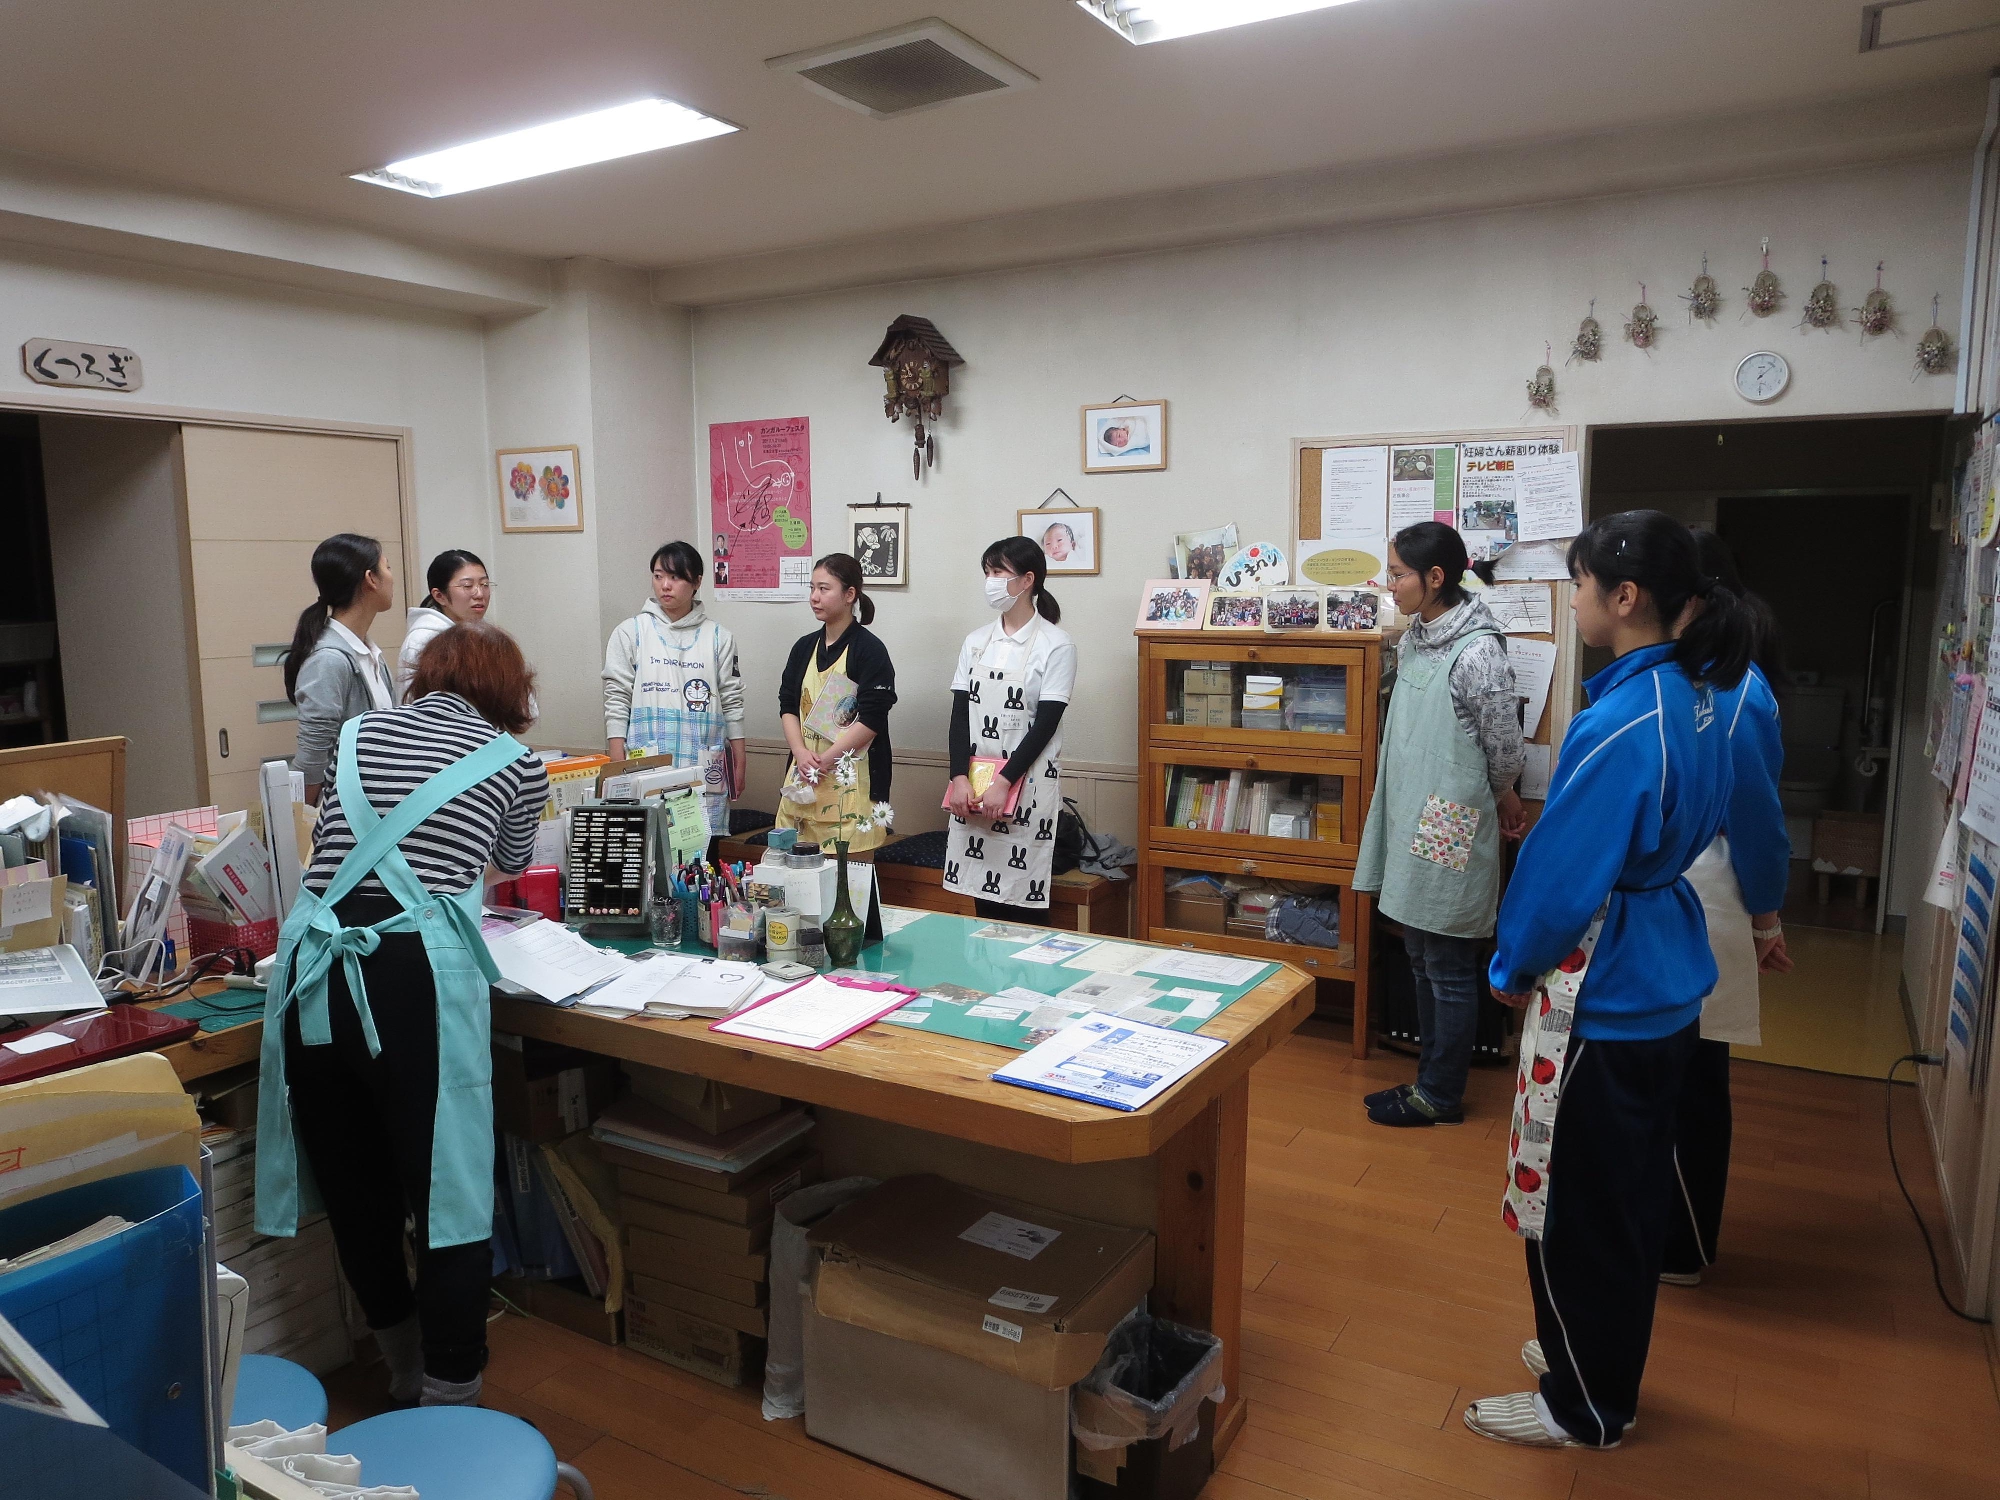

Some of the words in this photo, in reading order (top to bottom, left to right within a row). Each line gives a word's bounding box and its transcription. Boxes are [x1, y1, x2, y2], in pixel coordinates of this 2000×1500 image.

[33, 348, 133, 387] くつろぎ
[760, 425, 805, 434] カンガルーフェスタ
[1464, 443, 1560, 457] 妊婦さん薪割り体験
[1466, 460, 1515, 472] テレビ朝日
[1225, 553, 1277, 587] ひまわり
